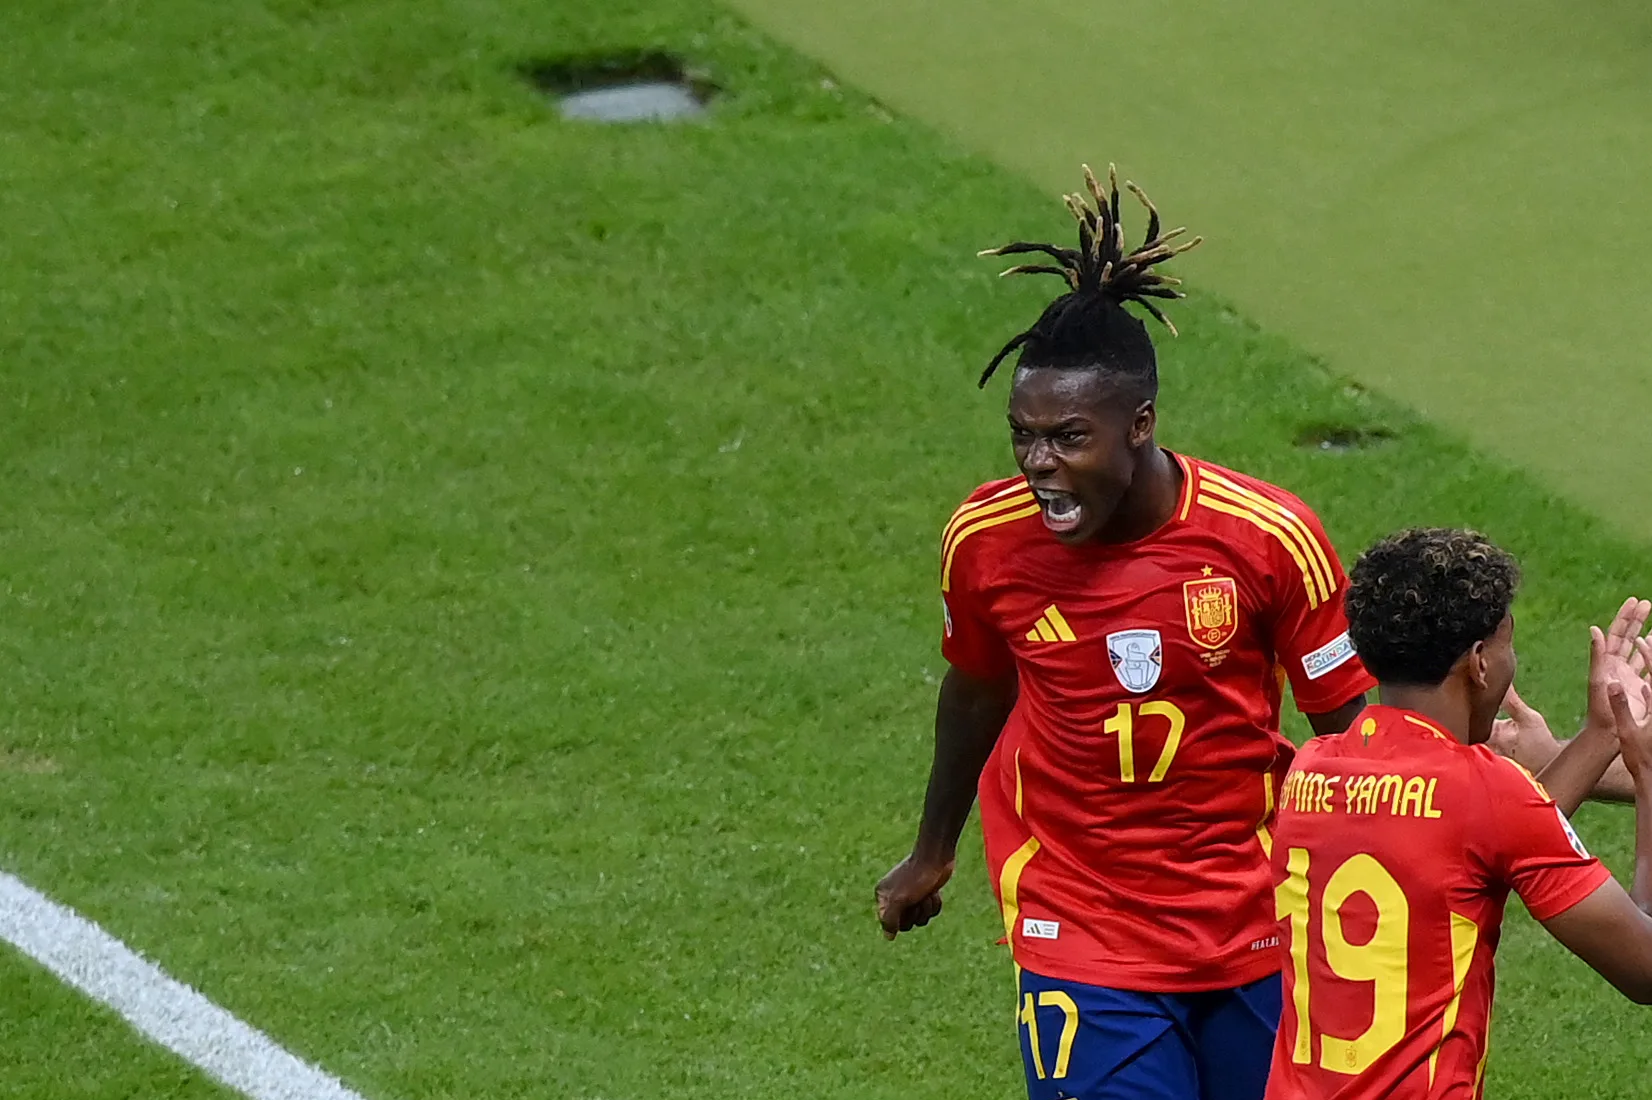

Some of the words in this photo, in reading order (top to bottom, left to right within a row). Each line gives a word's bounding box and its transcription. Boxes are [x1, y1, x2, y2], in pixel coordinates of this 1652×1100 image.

[1104, 701, 1185, 782] 17
[1345, 774, 1442, 818] YAMAL
[1275, 848, 1409, 1075] 19
[1021, 991, 1079, 1079] 17
